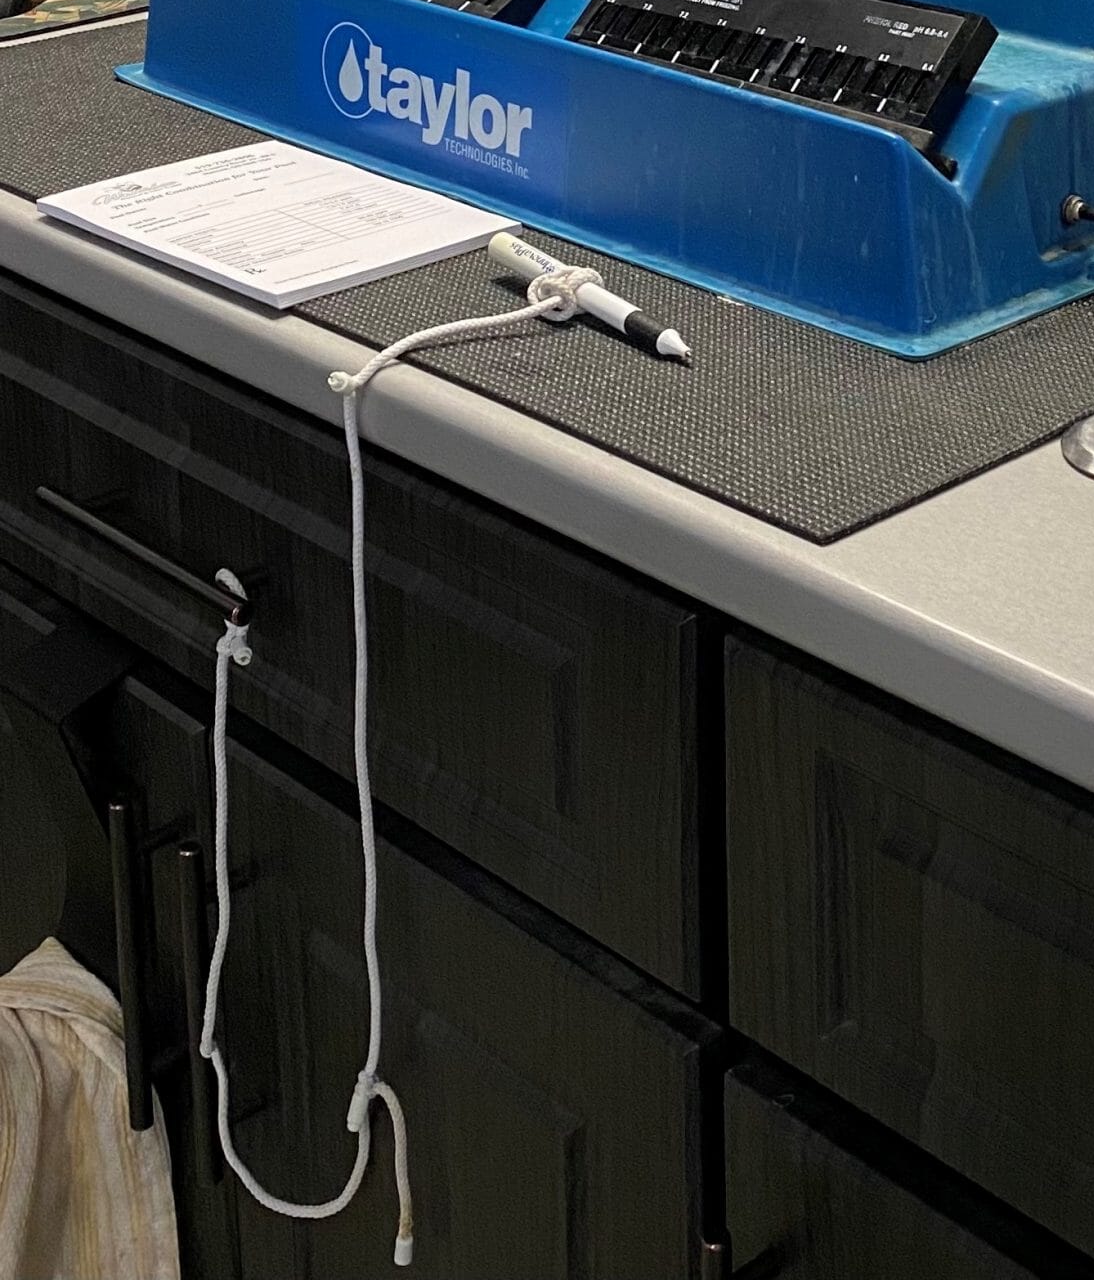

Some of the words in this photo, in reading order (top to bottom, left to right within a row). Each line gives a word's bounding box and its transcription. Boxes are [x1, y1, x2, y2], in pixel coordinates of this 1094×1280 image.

[364, 43, 532, 157] taylor
[443, 136, 514, 176] TECHNOLOGIES,
[515, 162, 531, 180] Inc.
